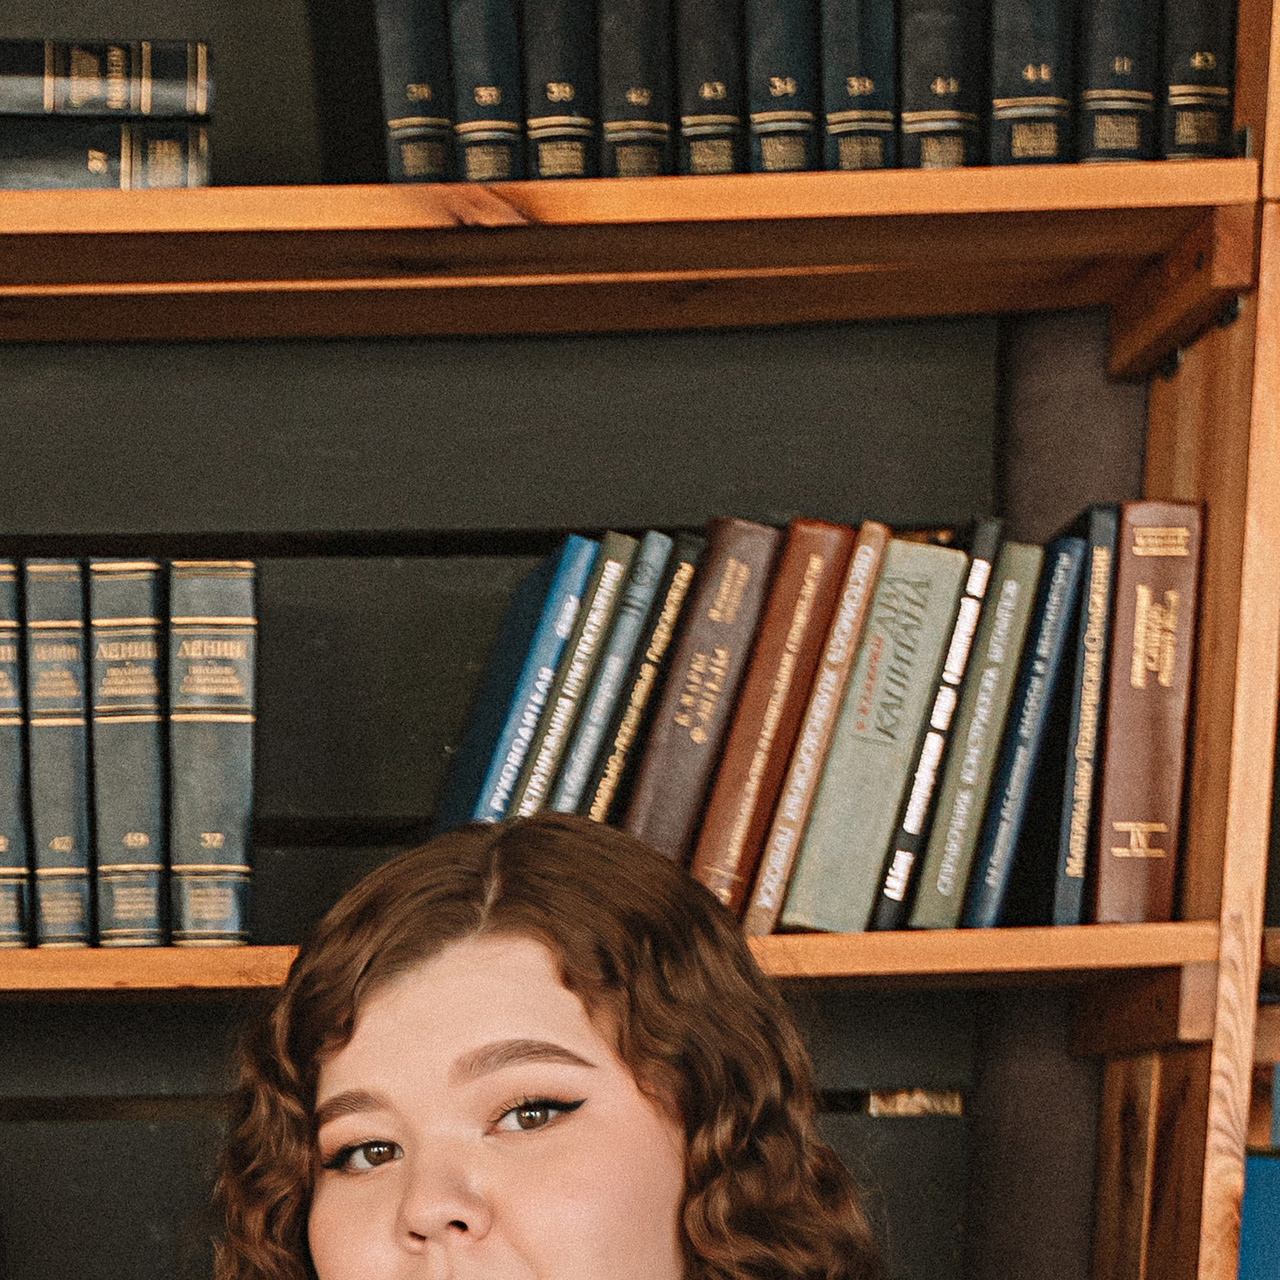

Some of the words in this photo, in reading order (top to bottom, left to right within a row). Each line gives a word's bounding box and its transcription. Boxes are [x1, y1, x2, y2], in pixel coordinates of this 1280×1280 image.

[95, 641, 158, 661] ЛЕНИН
[177, 640, 247, 659] ЛЕНИН
[824, 543, 877, 665] СЕБЕСТОИМОСТЬ
[486, 665, 558, 811] РУКОВОДИТЕЛЯ
[778, 665, 842, 822] ЖЕЛЕЗНОДОРОЖНЫХ
[933, 787, 973, 896] СПРАВОЧНИК
[958, 666, 1001, 786] КОНСТРУКТОРА
[985, 578, 1019, 665] ШТАМПОВ
[754, 820, 797, 909] ПЕРЕВОЗОК
